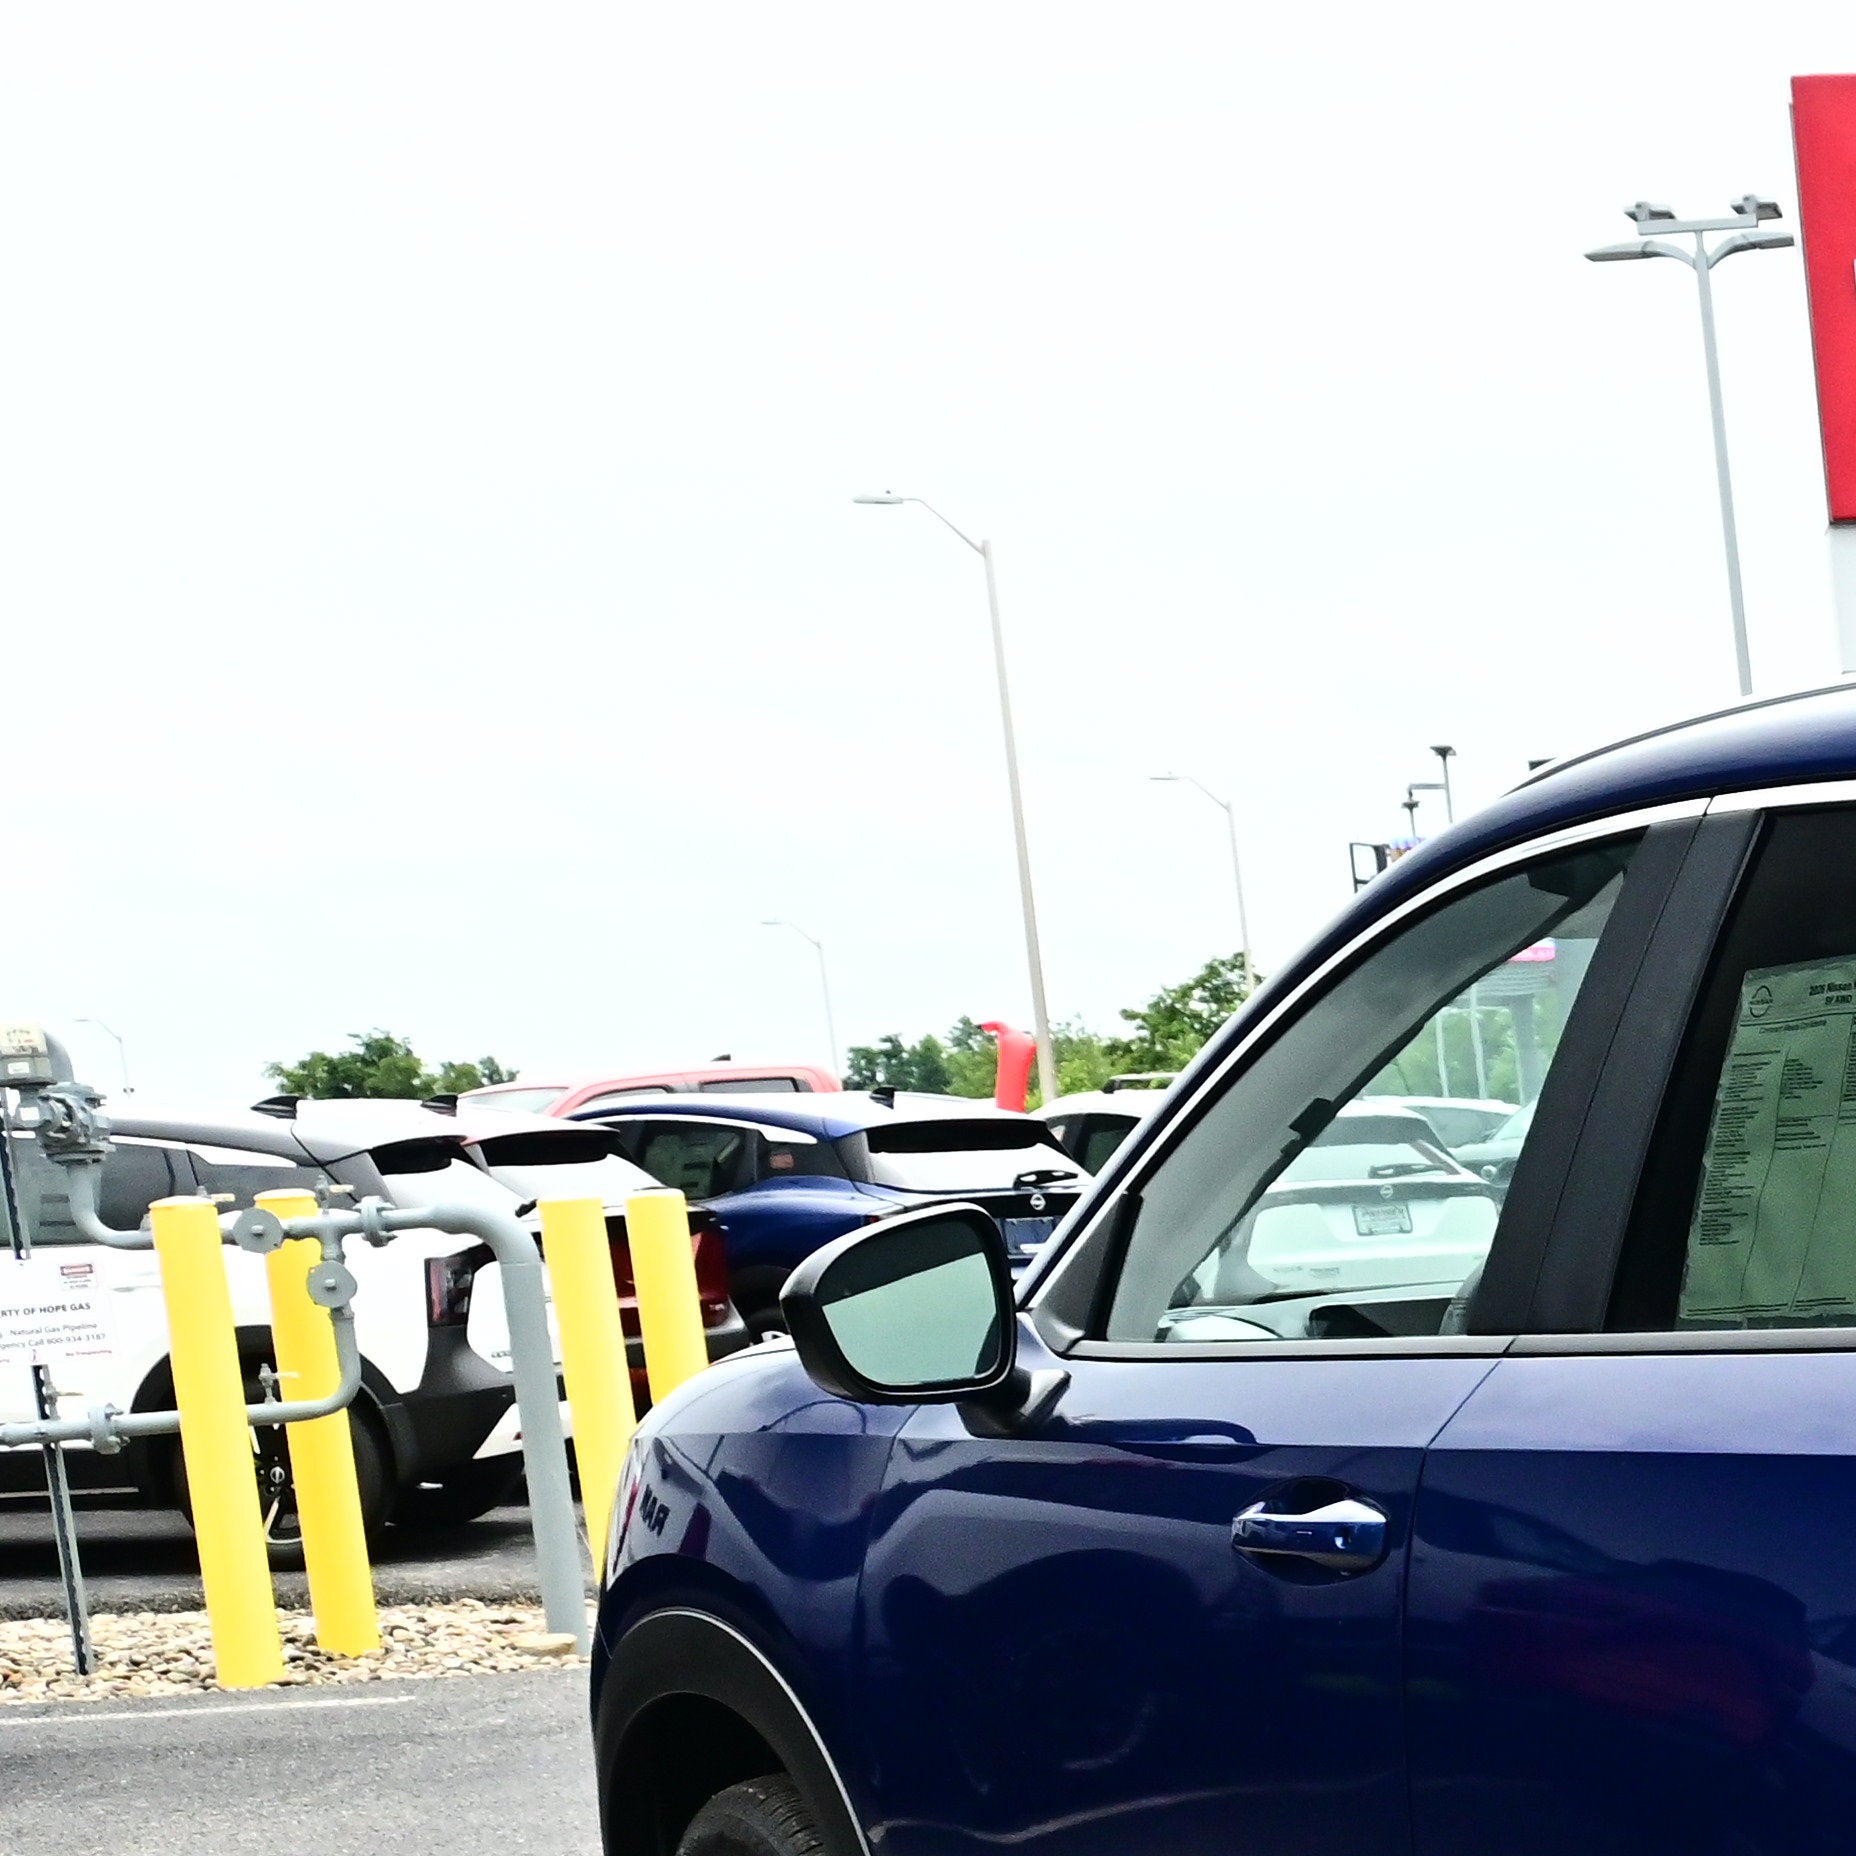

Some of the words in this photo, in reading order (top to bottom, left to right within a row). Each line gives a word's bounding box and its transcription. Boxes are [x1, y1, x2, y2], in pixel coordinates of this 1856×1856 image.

[23, 1306, 36, 1316] OF
[39, 1303, 67, 1314] HOPE
[70, 1302, 91, 1311] GAS
